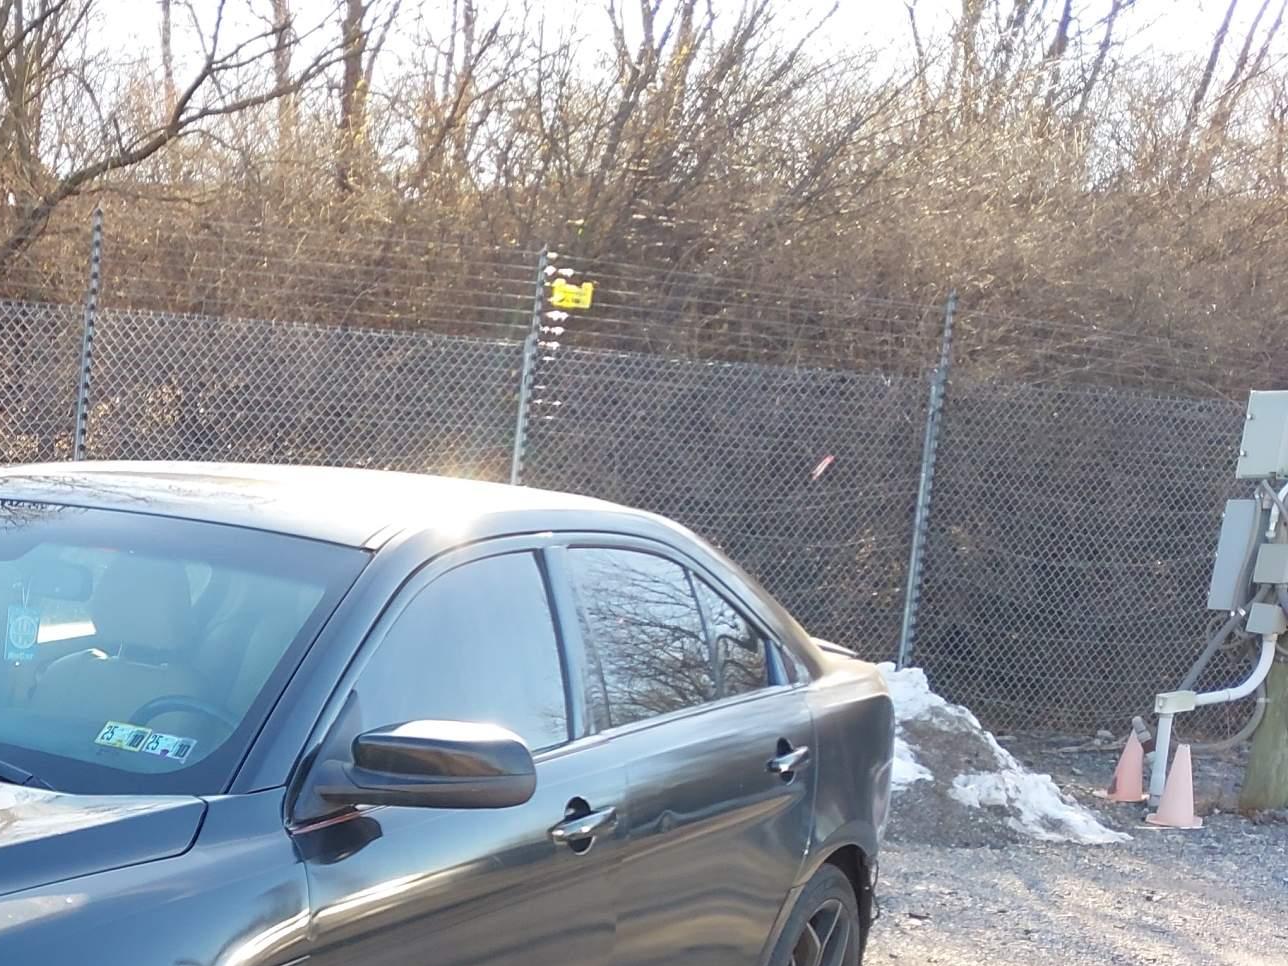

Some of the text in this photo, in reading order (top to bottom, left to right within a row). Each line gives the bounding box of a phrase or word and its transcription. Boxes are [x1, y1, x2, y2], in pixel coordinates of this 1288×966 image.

[100, 725, 146, 748] 25 10
[145, 734, 191, 758] 25 10
